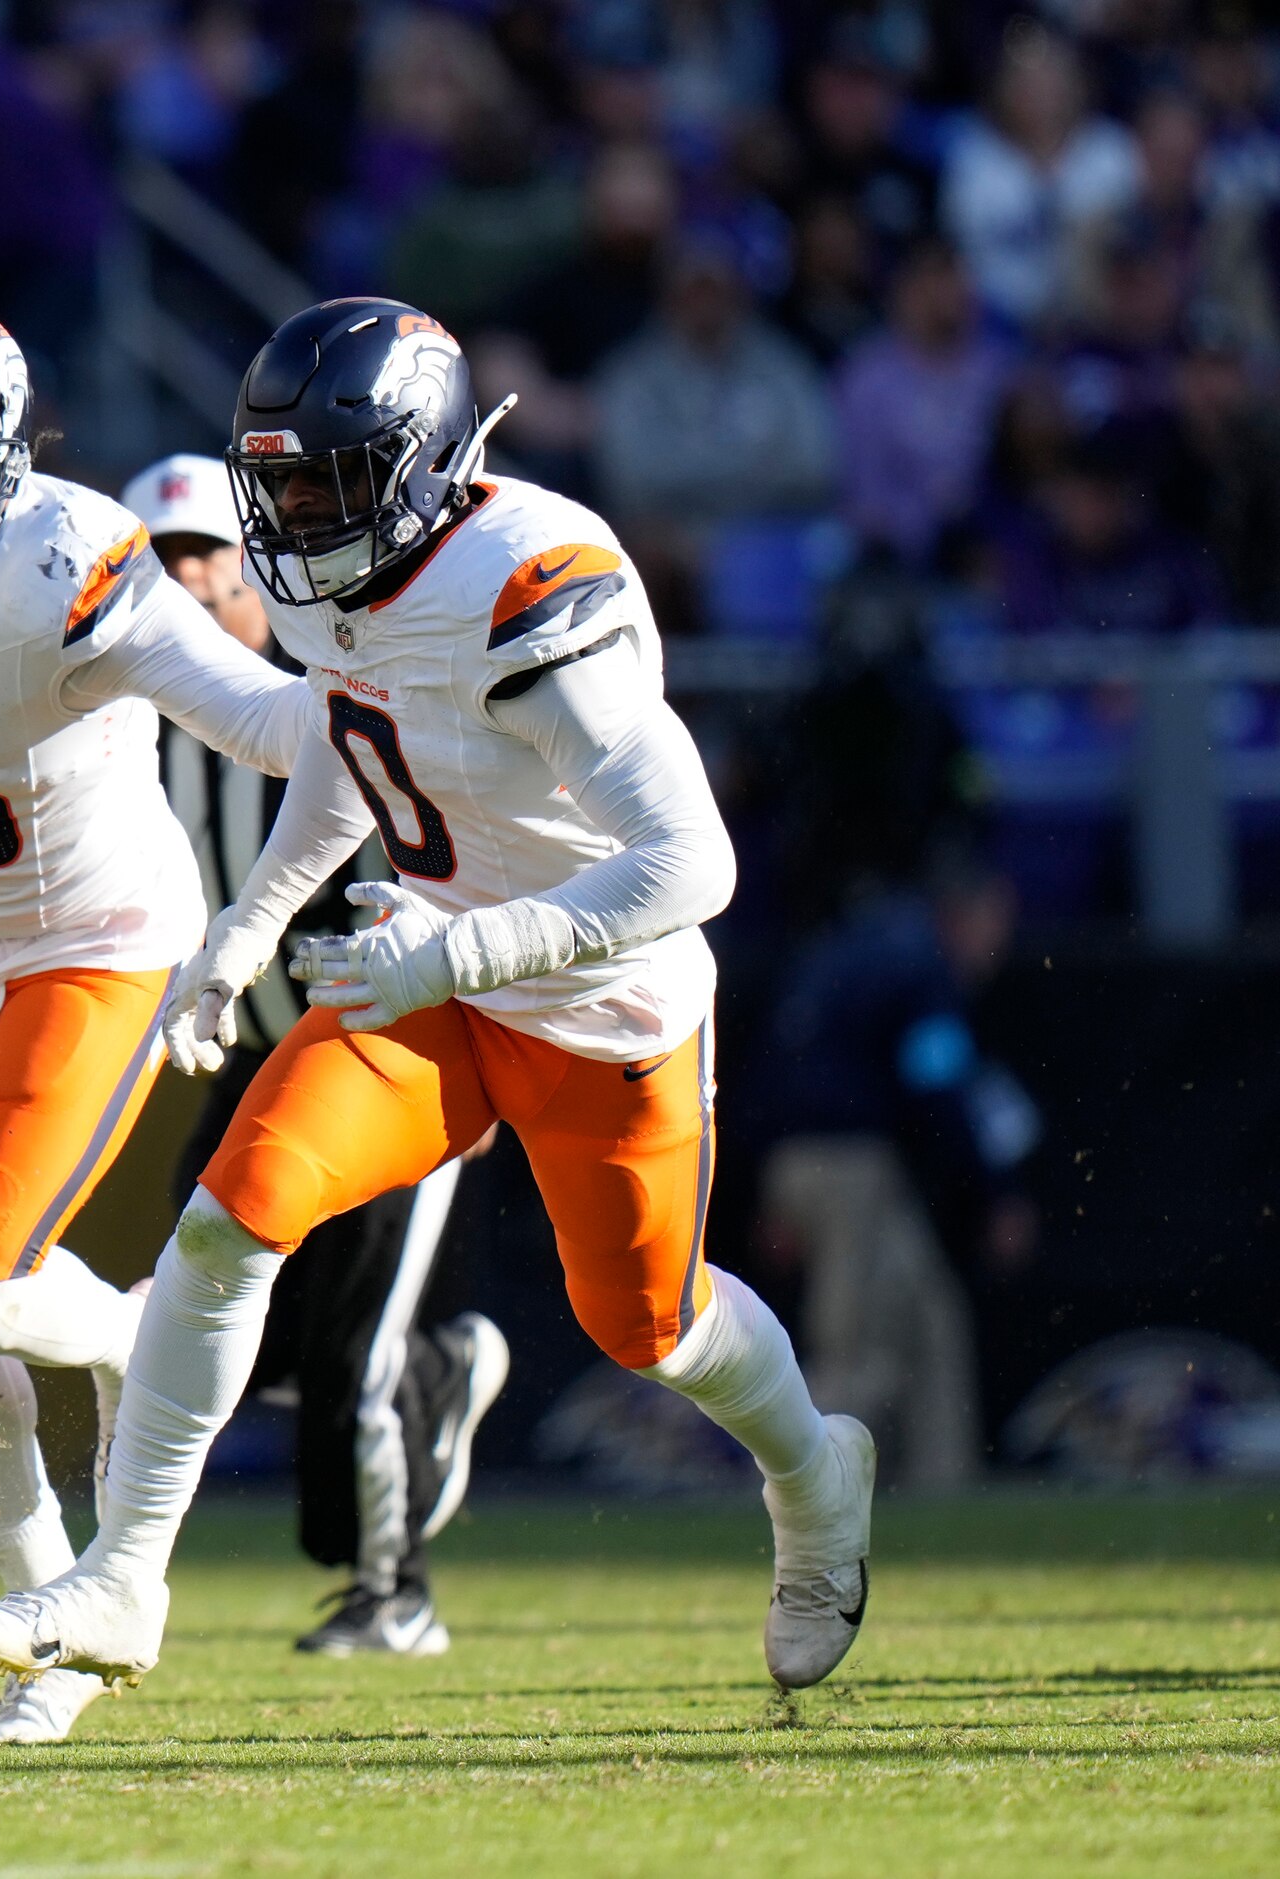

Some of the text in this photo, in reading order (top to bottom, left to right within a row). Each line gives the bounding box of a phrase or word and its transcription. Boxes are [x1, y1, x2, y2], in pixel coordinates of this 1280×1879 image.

[246, 434, 284, 454] 5280
[336, 633, 352, 649] NFL
[327, 690, 458, 882] 0
